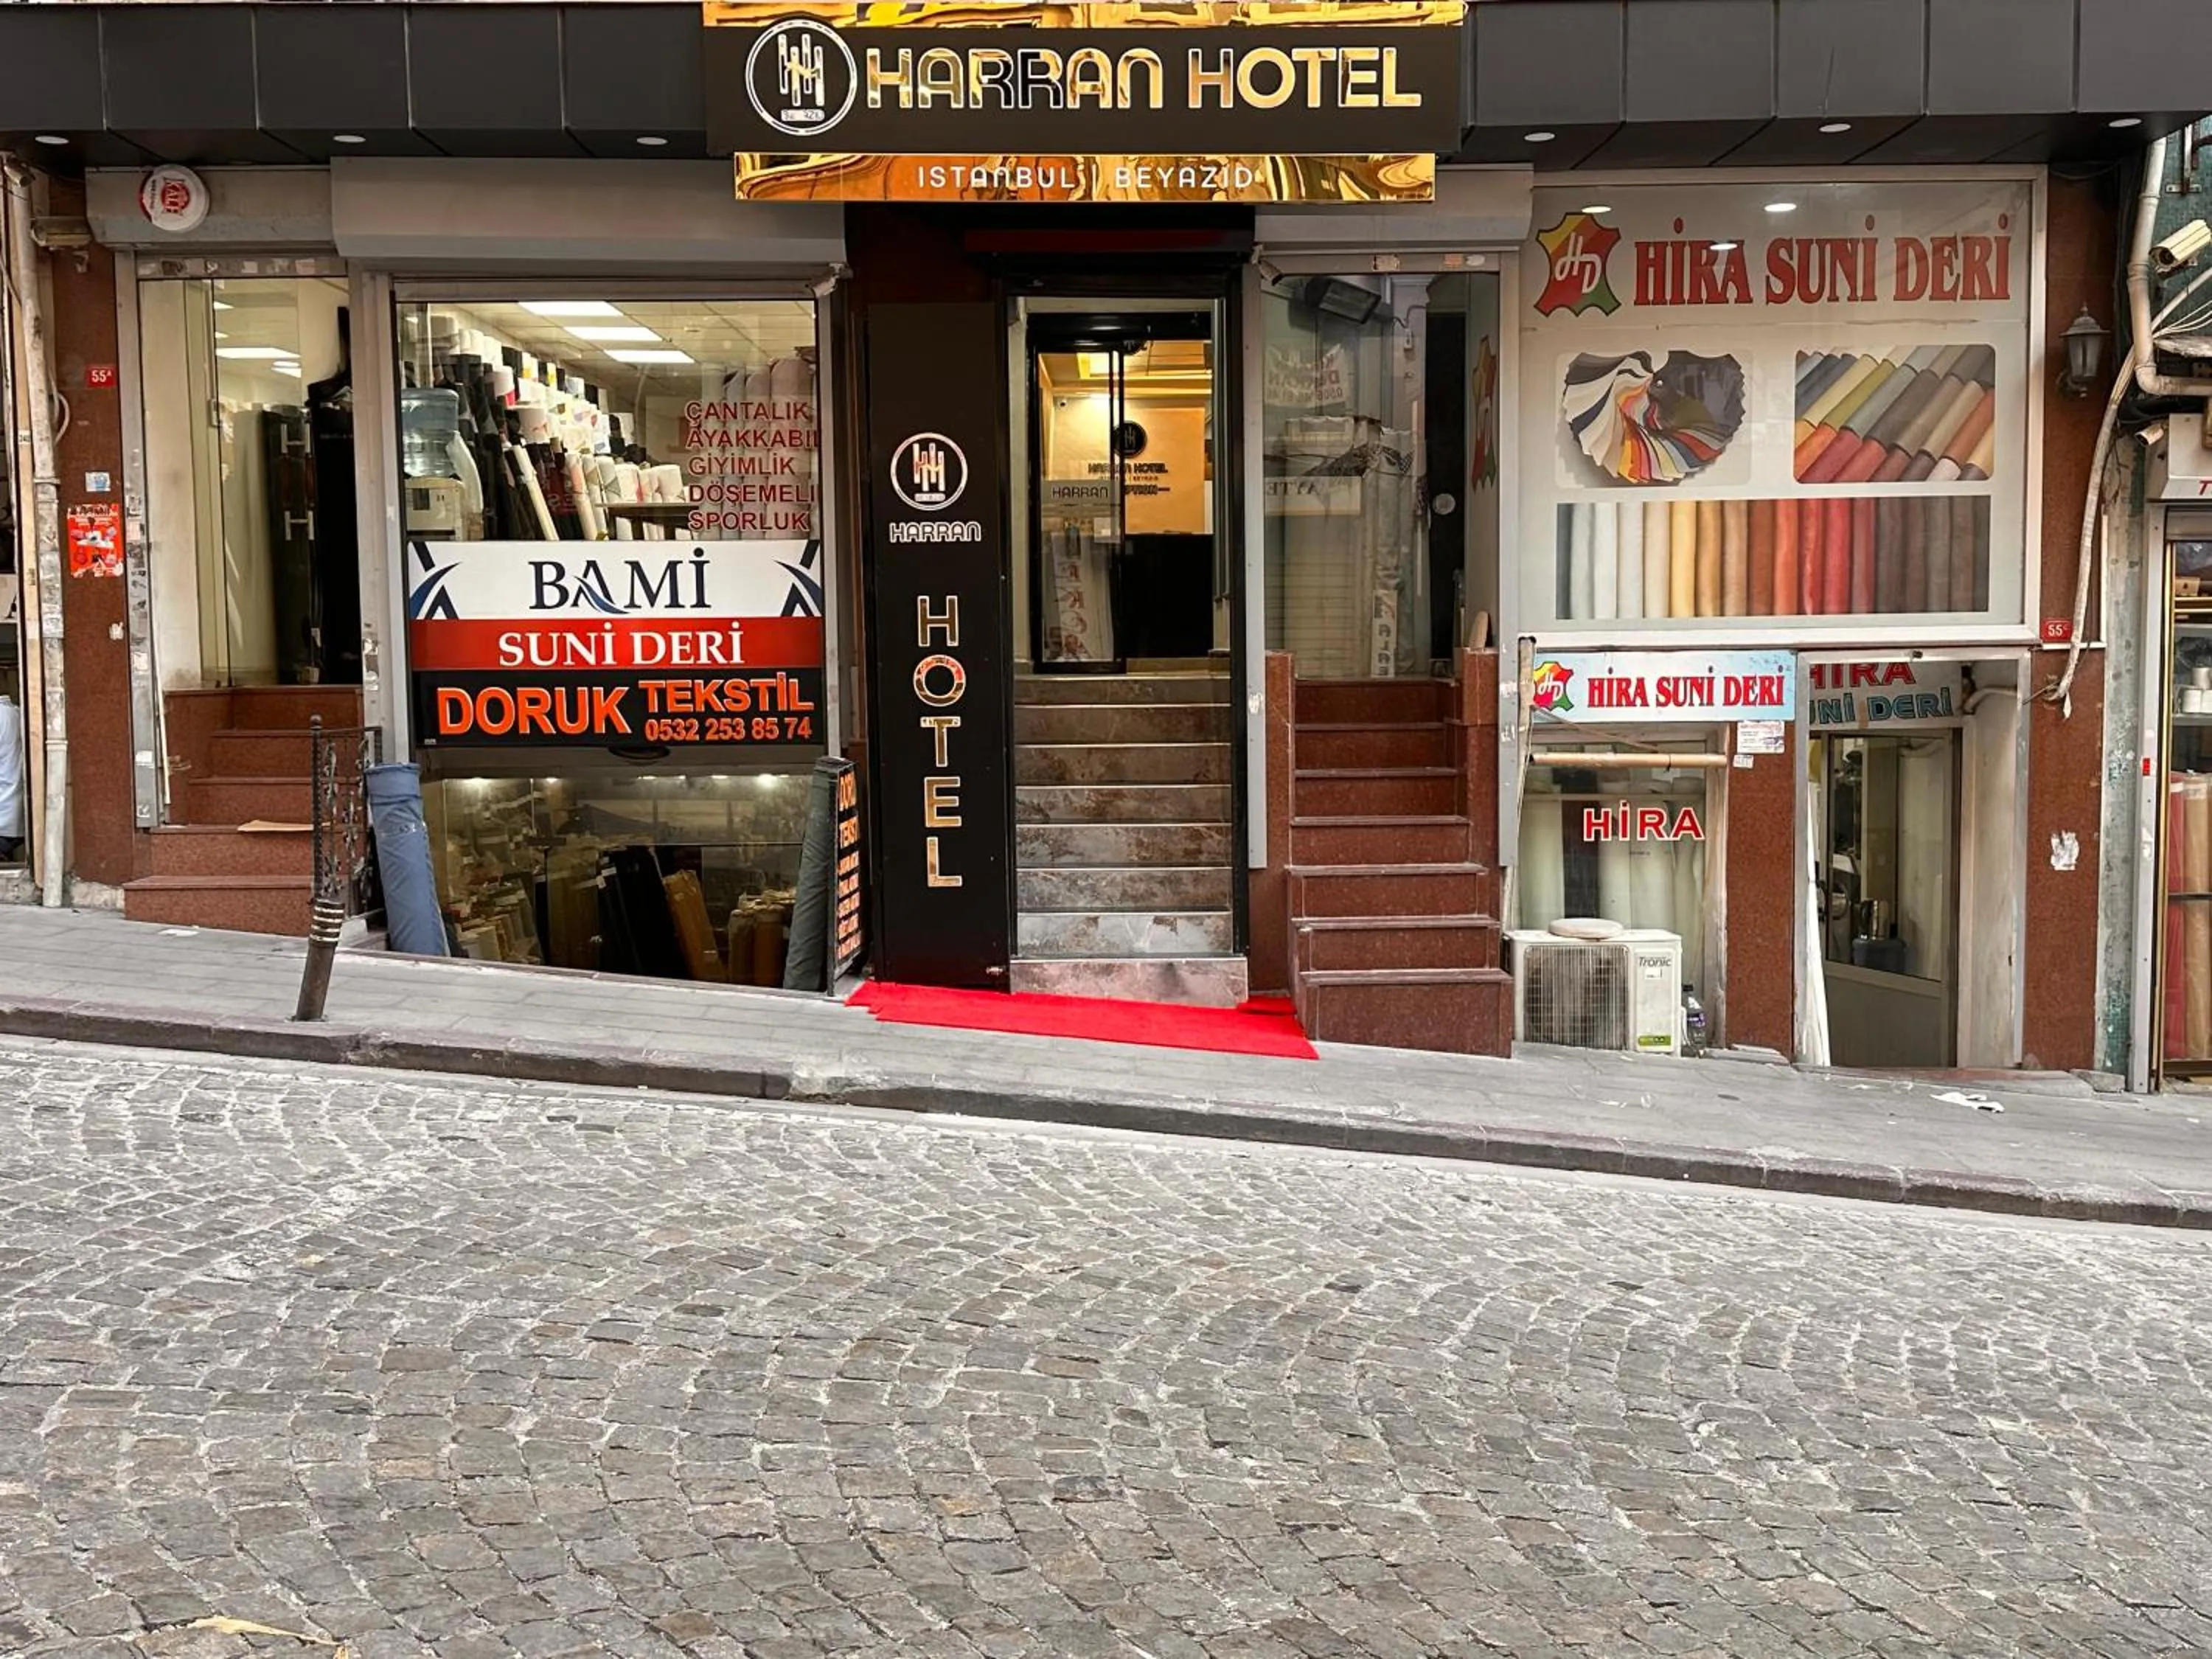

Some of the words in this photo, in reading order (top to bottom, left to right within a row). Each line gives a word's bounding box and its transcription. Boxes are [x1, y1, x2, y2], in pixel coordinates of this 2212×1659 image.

[866, 47, 1164, 110] HARRAN
[1186, 46, 1422, 108] HOTEL
[918, 166, 1077, 189] ISTANBUL
[1114, 164, 1255, 189] BEYAZID
[1633, 217, 1753, 306] HİRA
[1766, 215, 1878, 305] SUNİ
[1893, 213, 2011, 301] DERİ
[686, 402, 811, 427] ÇANTALIK
[689, 453, 796, 476] GİYİMLİK
[1052, 486, 1108, 498] HARRAN
[689, 511, 810, 531] SPORLUK
[889, 521, 981, 543] HARRAN
[528, 547, 712, 613] BAMİ
[499, 622, 616, 667] SUNİ
[631, 621, 745, 664] DERİ
[1587, 666, 1649, 708] HİRA
[1655, 665, 1715, 707] SUNİ
[1722, 665, 1785, 706] DERİ
[1867, 686, 1954, 720] DERİ
[437, 686, 633, 736] DORUK
[638, 672, 815, 713] TEKSTİL
[644, 720, 700, 742] 0532
[705, 718, 747, 740] 253
[751, 718, 779, 740] 85
[785, 717, 813, 739] 74
[913, 595, 967, 886] HOTEL
[1583, 800, 1705, 841] HİRA
[1639, 956, 1672, 967] Tronic
